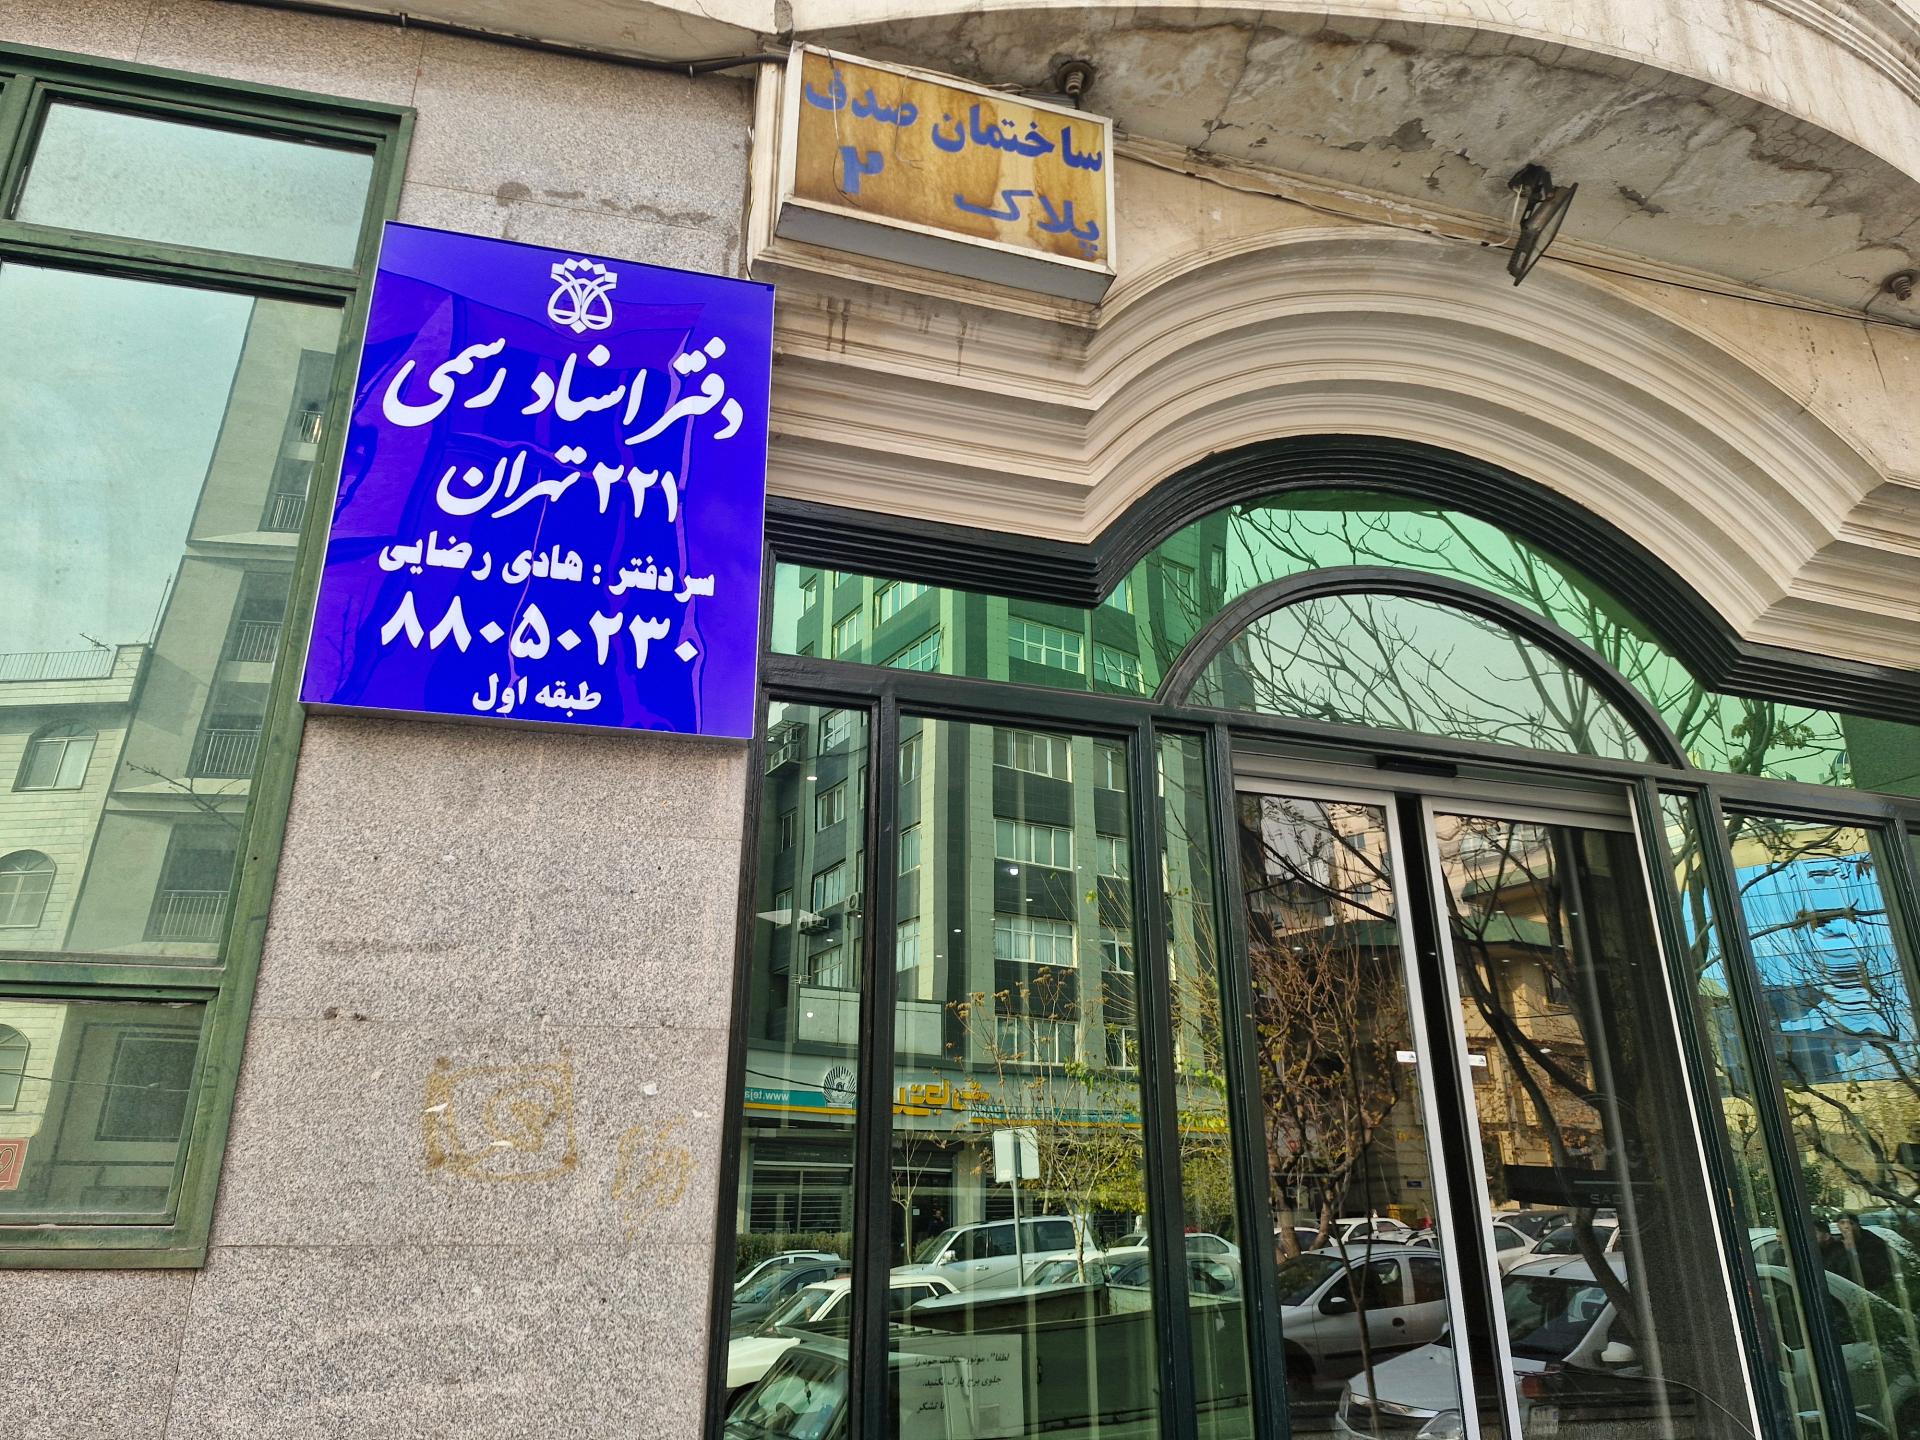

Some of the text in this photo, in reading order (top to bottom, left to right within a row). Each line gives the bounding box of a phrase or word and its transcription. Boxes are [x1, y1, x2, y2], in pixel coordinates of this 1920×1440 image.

[804, 69, 1103, 172] ساختمان صدف
[953, 189, 1100, 258] پلاک
[382, 336, 744, 446] دفتر اسناد رسمی
[436, 445, 678, 523] ۲۲۱ تهران
[378, 530, 492, 581] رضایی
[501, 544, 583, 584] هادی
[381, 590, 698, 669] ۸۸۰۵۰۲۳۰
[472, 672, 602, 717] طبقه اول
